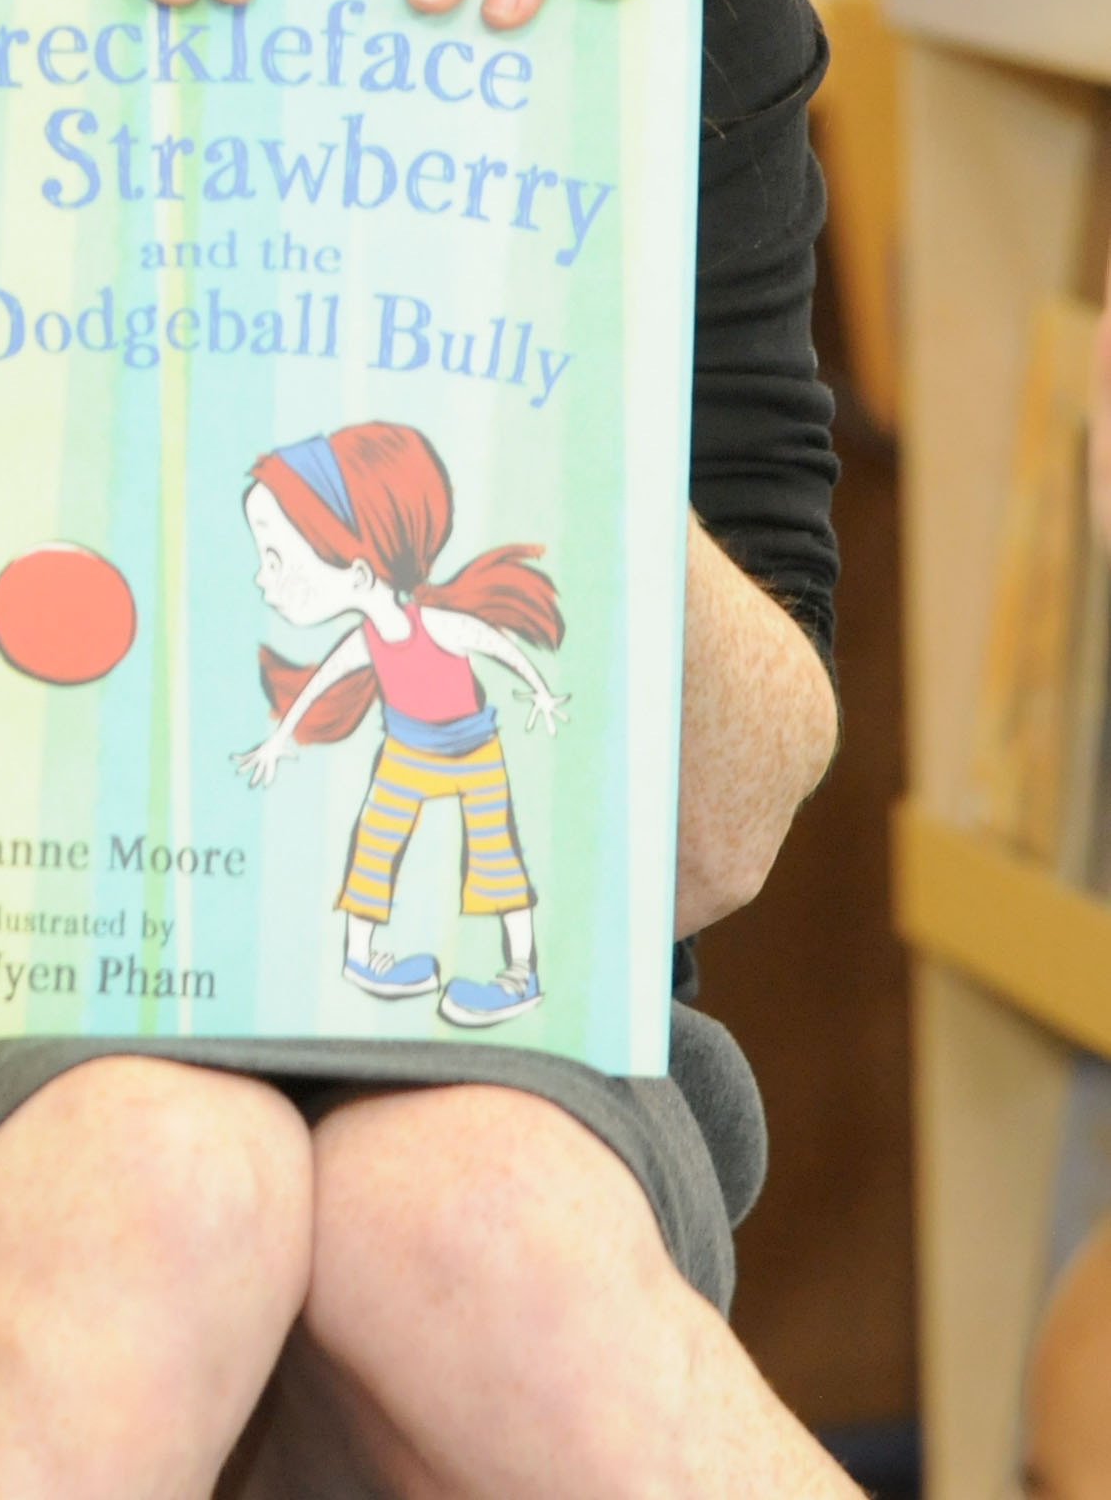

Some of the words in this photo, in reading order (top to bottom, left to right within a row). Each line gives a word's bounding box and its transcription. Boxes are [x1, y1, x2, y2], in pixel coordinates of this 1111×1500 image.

[41, 108, 617, 267] Strawberry
[140, 233, 238, 271] and
[260, 235, 342, 274] the
[369, 293, 575, 408] Bully
[108, 834, 246, 877] Moore
[141, 910, 175, 946] by
[98, 953, 217, 999] Pham
